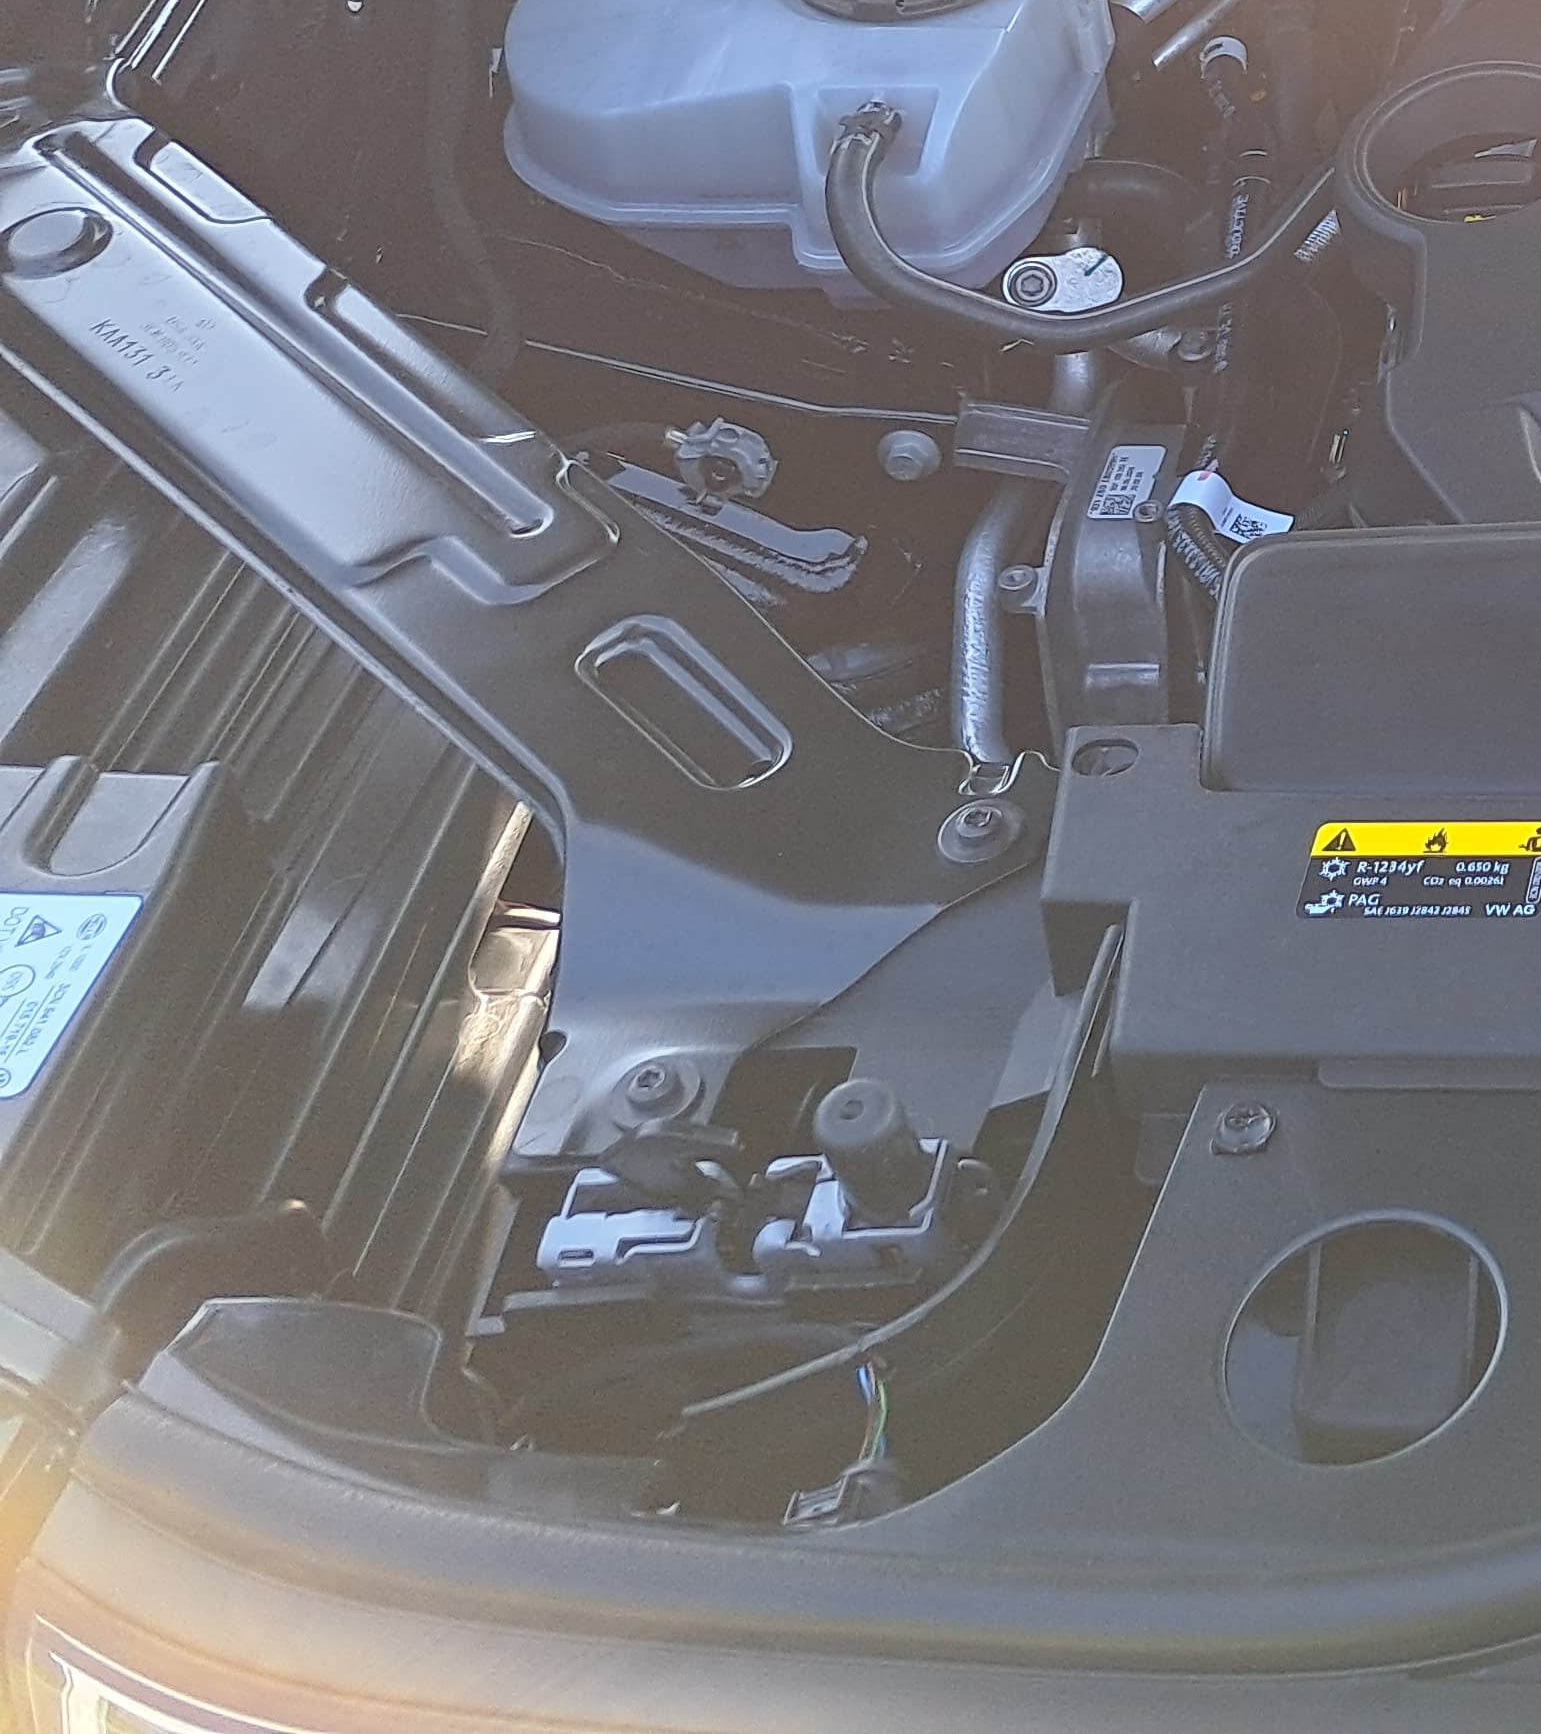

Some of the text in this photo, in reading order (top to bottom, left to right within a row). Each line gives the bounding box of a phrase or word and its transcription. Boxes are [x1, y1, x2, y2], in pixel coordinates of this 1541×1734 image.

[1357, 860, 1424, 875] R-1234yf
[1493, 862, 1509, 875] kg
[1349, 893, 1381, 906] PAG
[1485, 904, 1536, 915] VW AG
